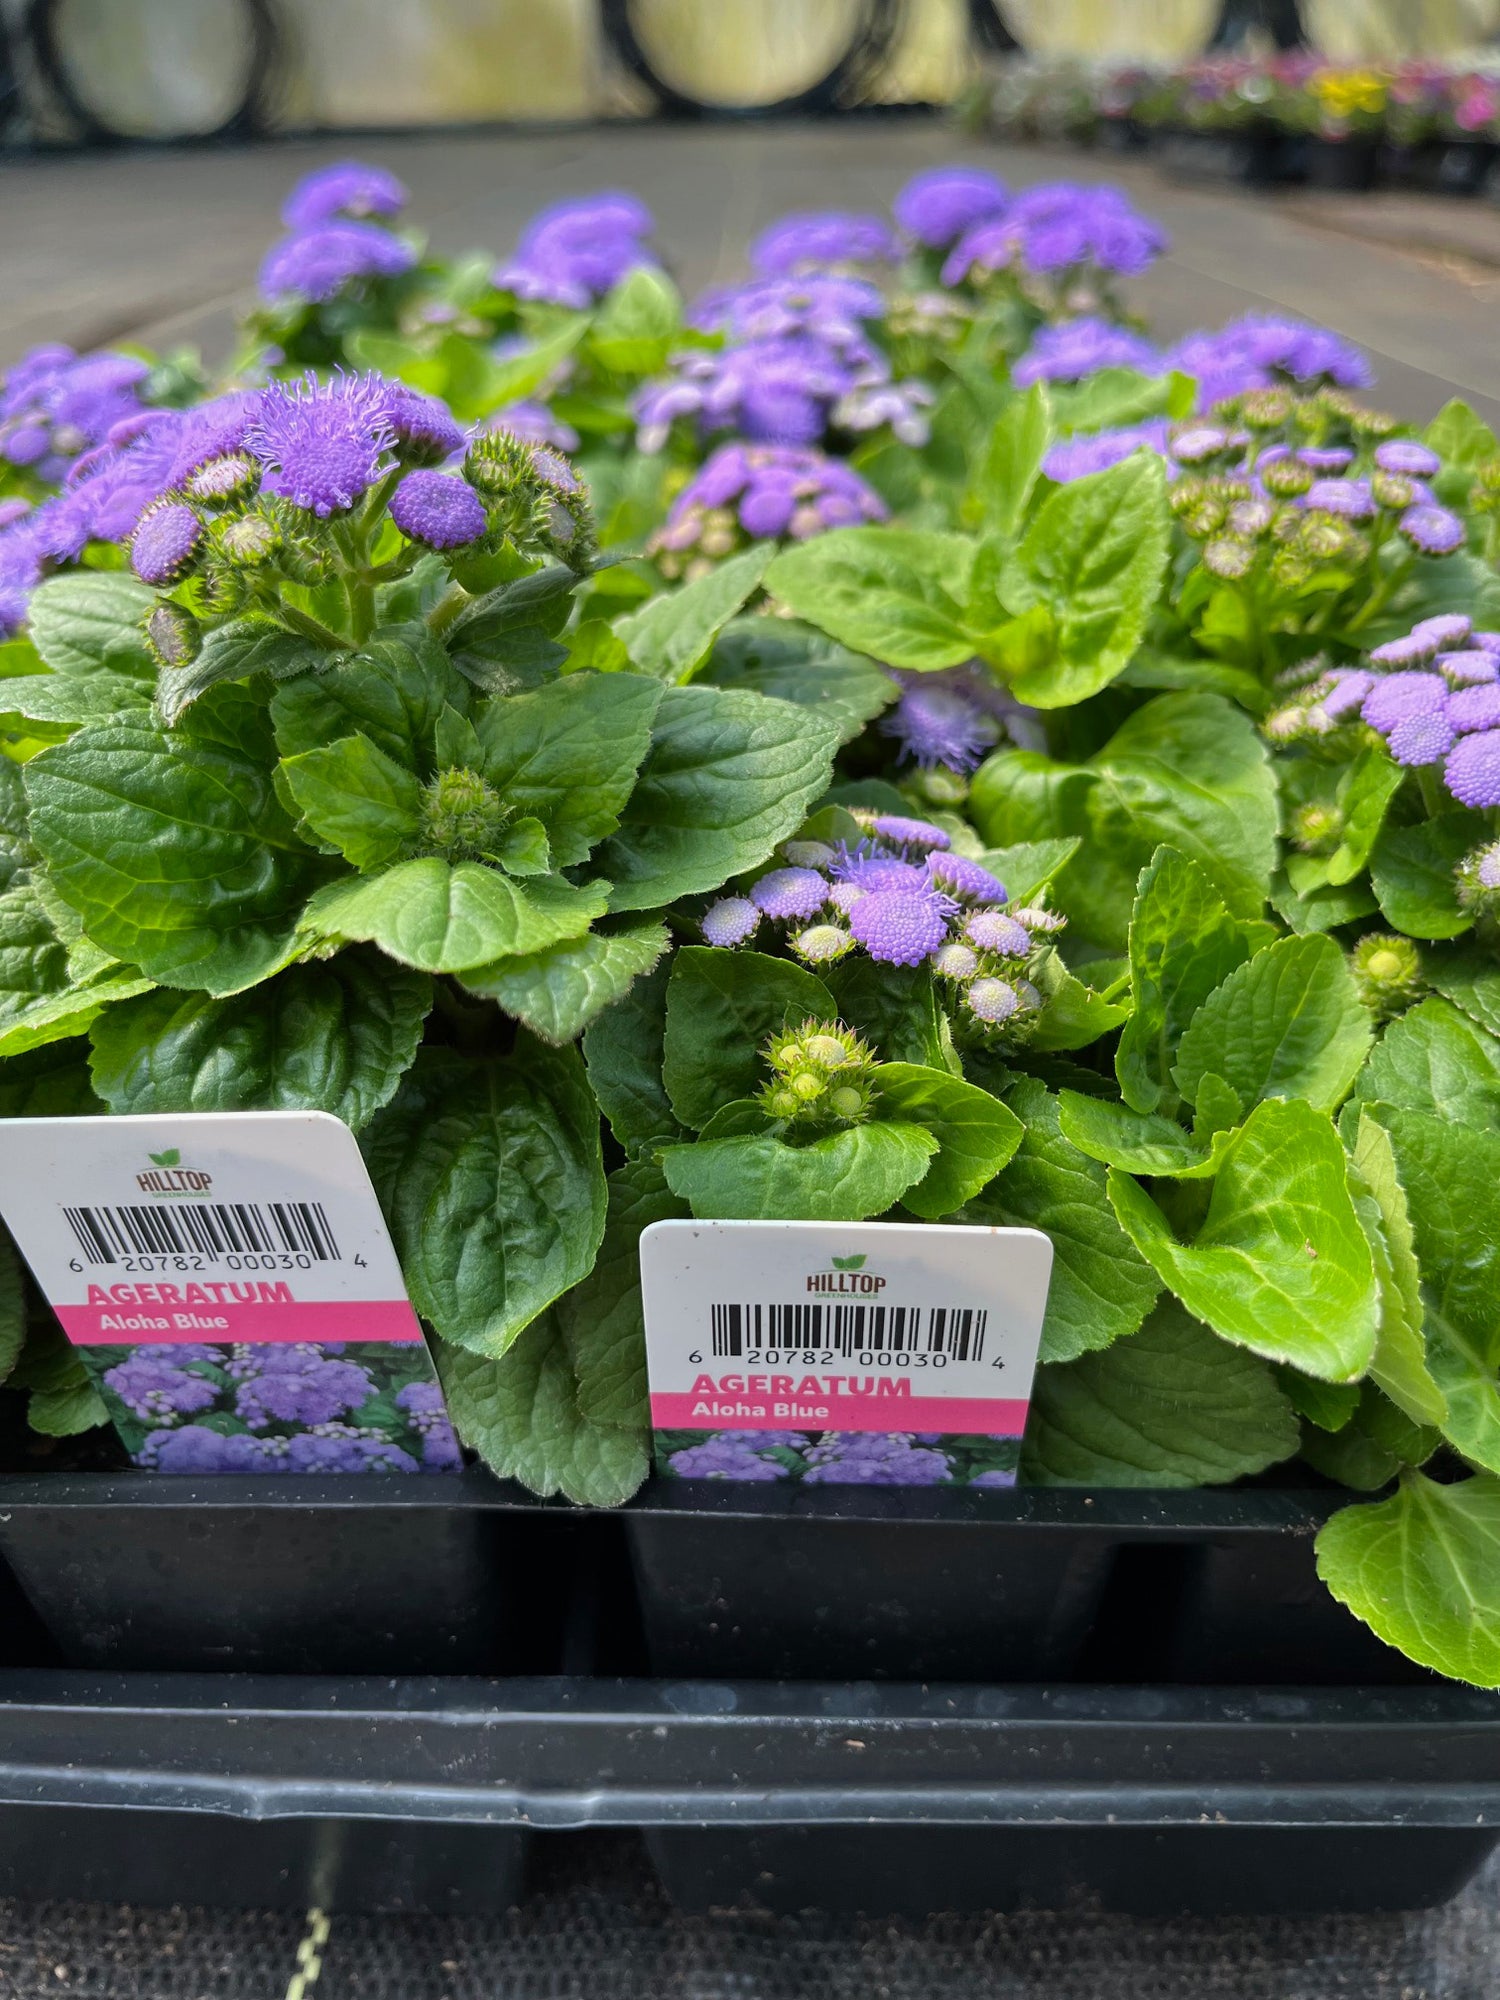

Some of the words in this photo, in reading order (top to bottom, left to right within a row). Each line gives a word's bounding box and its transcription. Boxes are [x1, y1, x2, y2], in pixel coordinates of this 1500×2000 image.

[136, 1170, 213, 1193] HILLTOP
[70, 1257, 84, 1273] 6
[124, 1256, 207, 1272] 20782
[227, 1254, 312, 1270] 00030
[354, 1253, 368, 1268] 4
[86, 1281, 296, 1305] AGERATUM
[806, 1273, 887, 1294] HILLTOP
[100, 1313, 171, 1331] Aloha
[176, 1313, 230, 1330] Blue
[688, 1349, 703, 1364] 6
[747, 1350, 835, 1365] 20782
[858, 1352, 948, 1369] 00030
[992, 1356, 1006, 1370] 4
[689, 1373, 912, 1398] AGERATUM
[691, 1401, 767, 1418] Aloha
[773, 1402, 830, 1418] Blue
